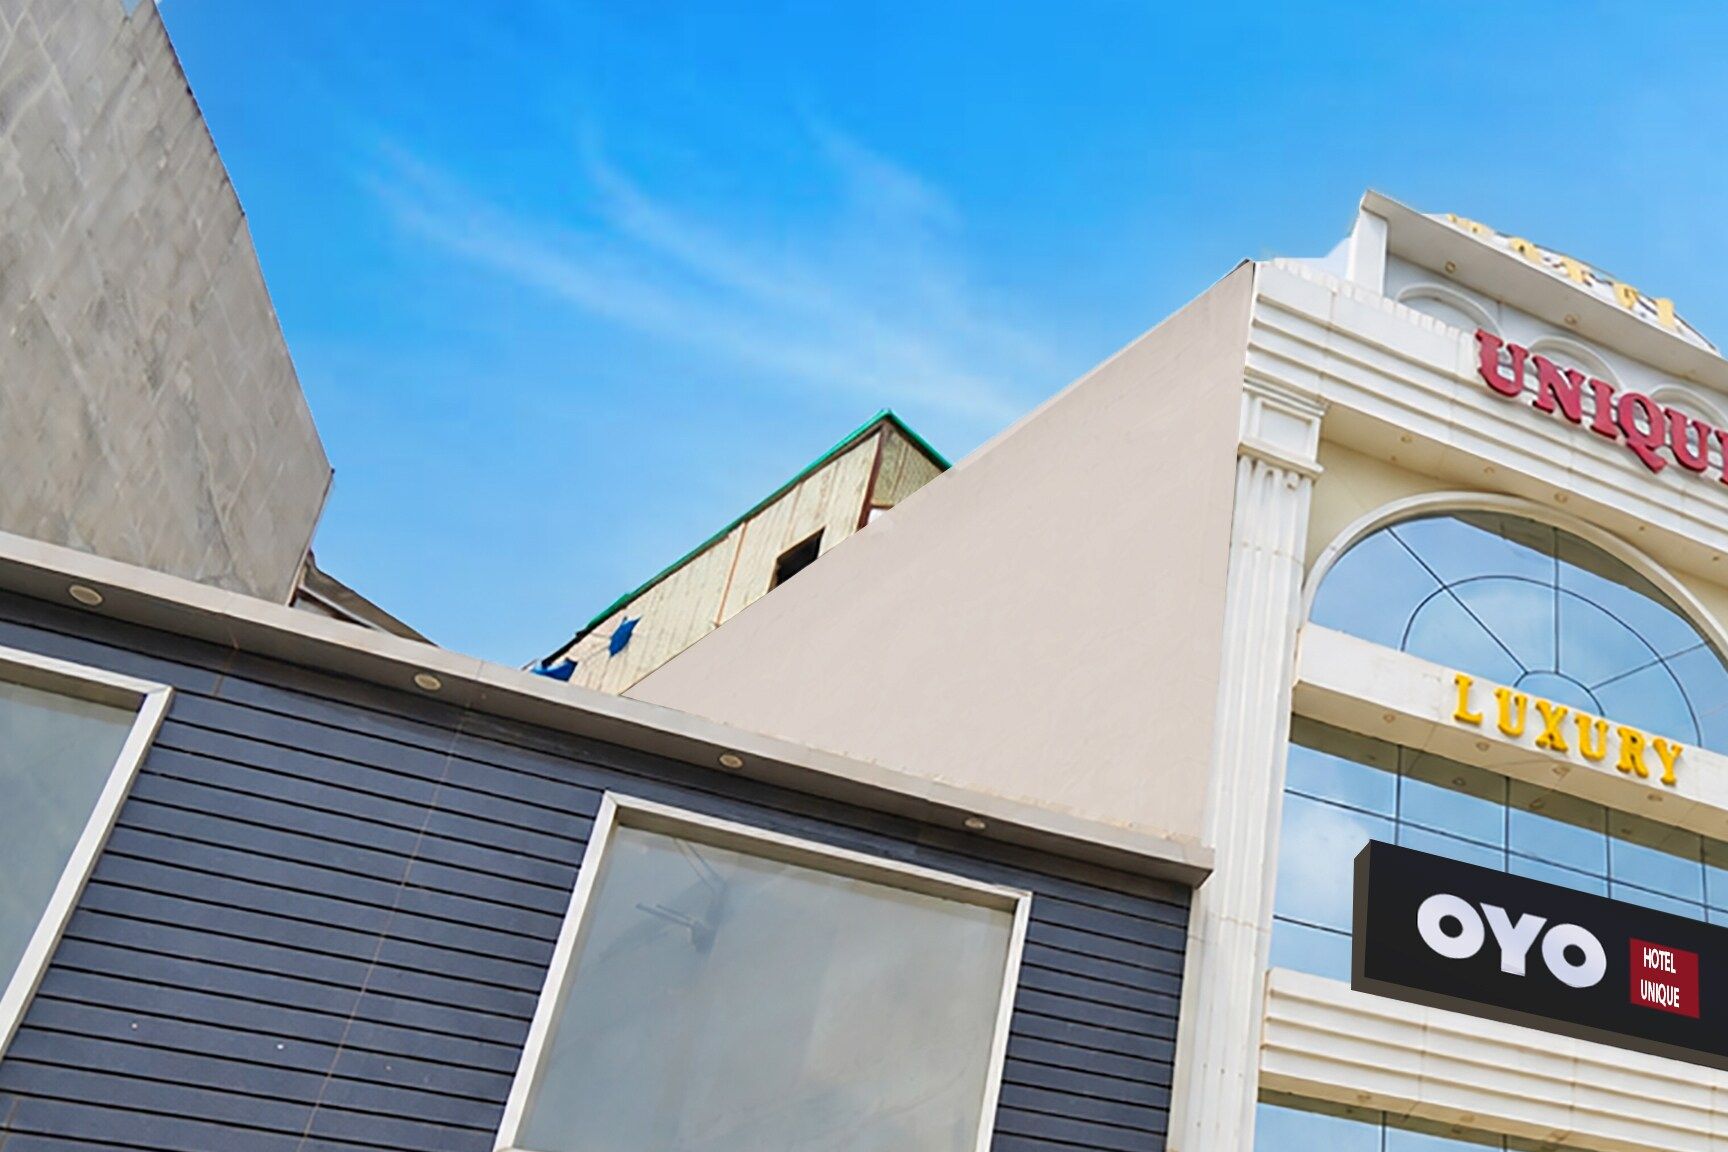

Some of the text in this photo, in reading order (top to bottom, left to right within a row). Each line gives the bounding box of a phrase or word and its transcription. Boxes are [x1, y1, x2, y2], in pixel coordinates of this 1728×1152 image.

[1453, 674, 1684, 786] LUXURY
[1417, 893, 1607, 988] OYO
[1643, 947, 1677, 975] HOTEL
[1640, 979, 1680, 1008] UNIQUE
